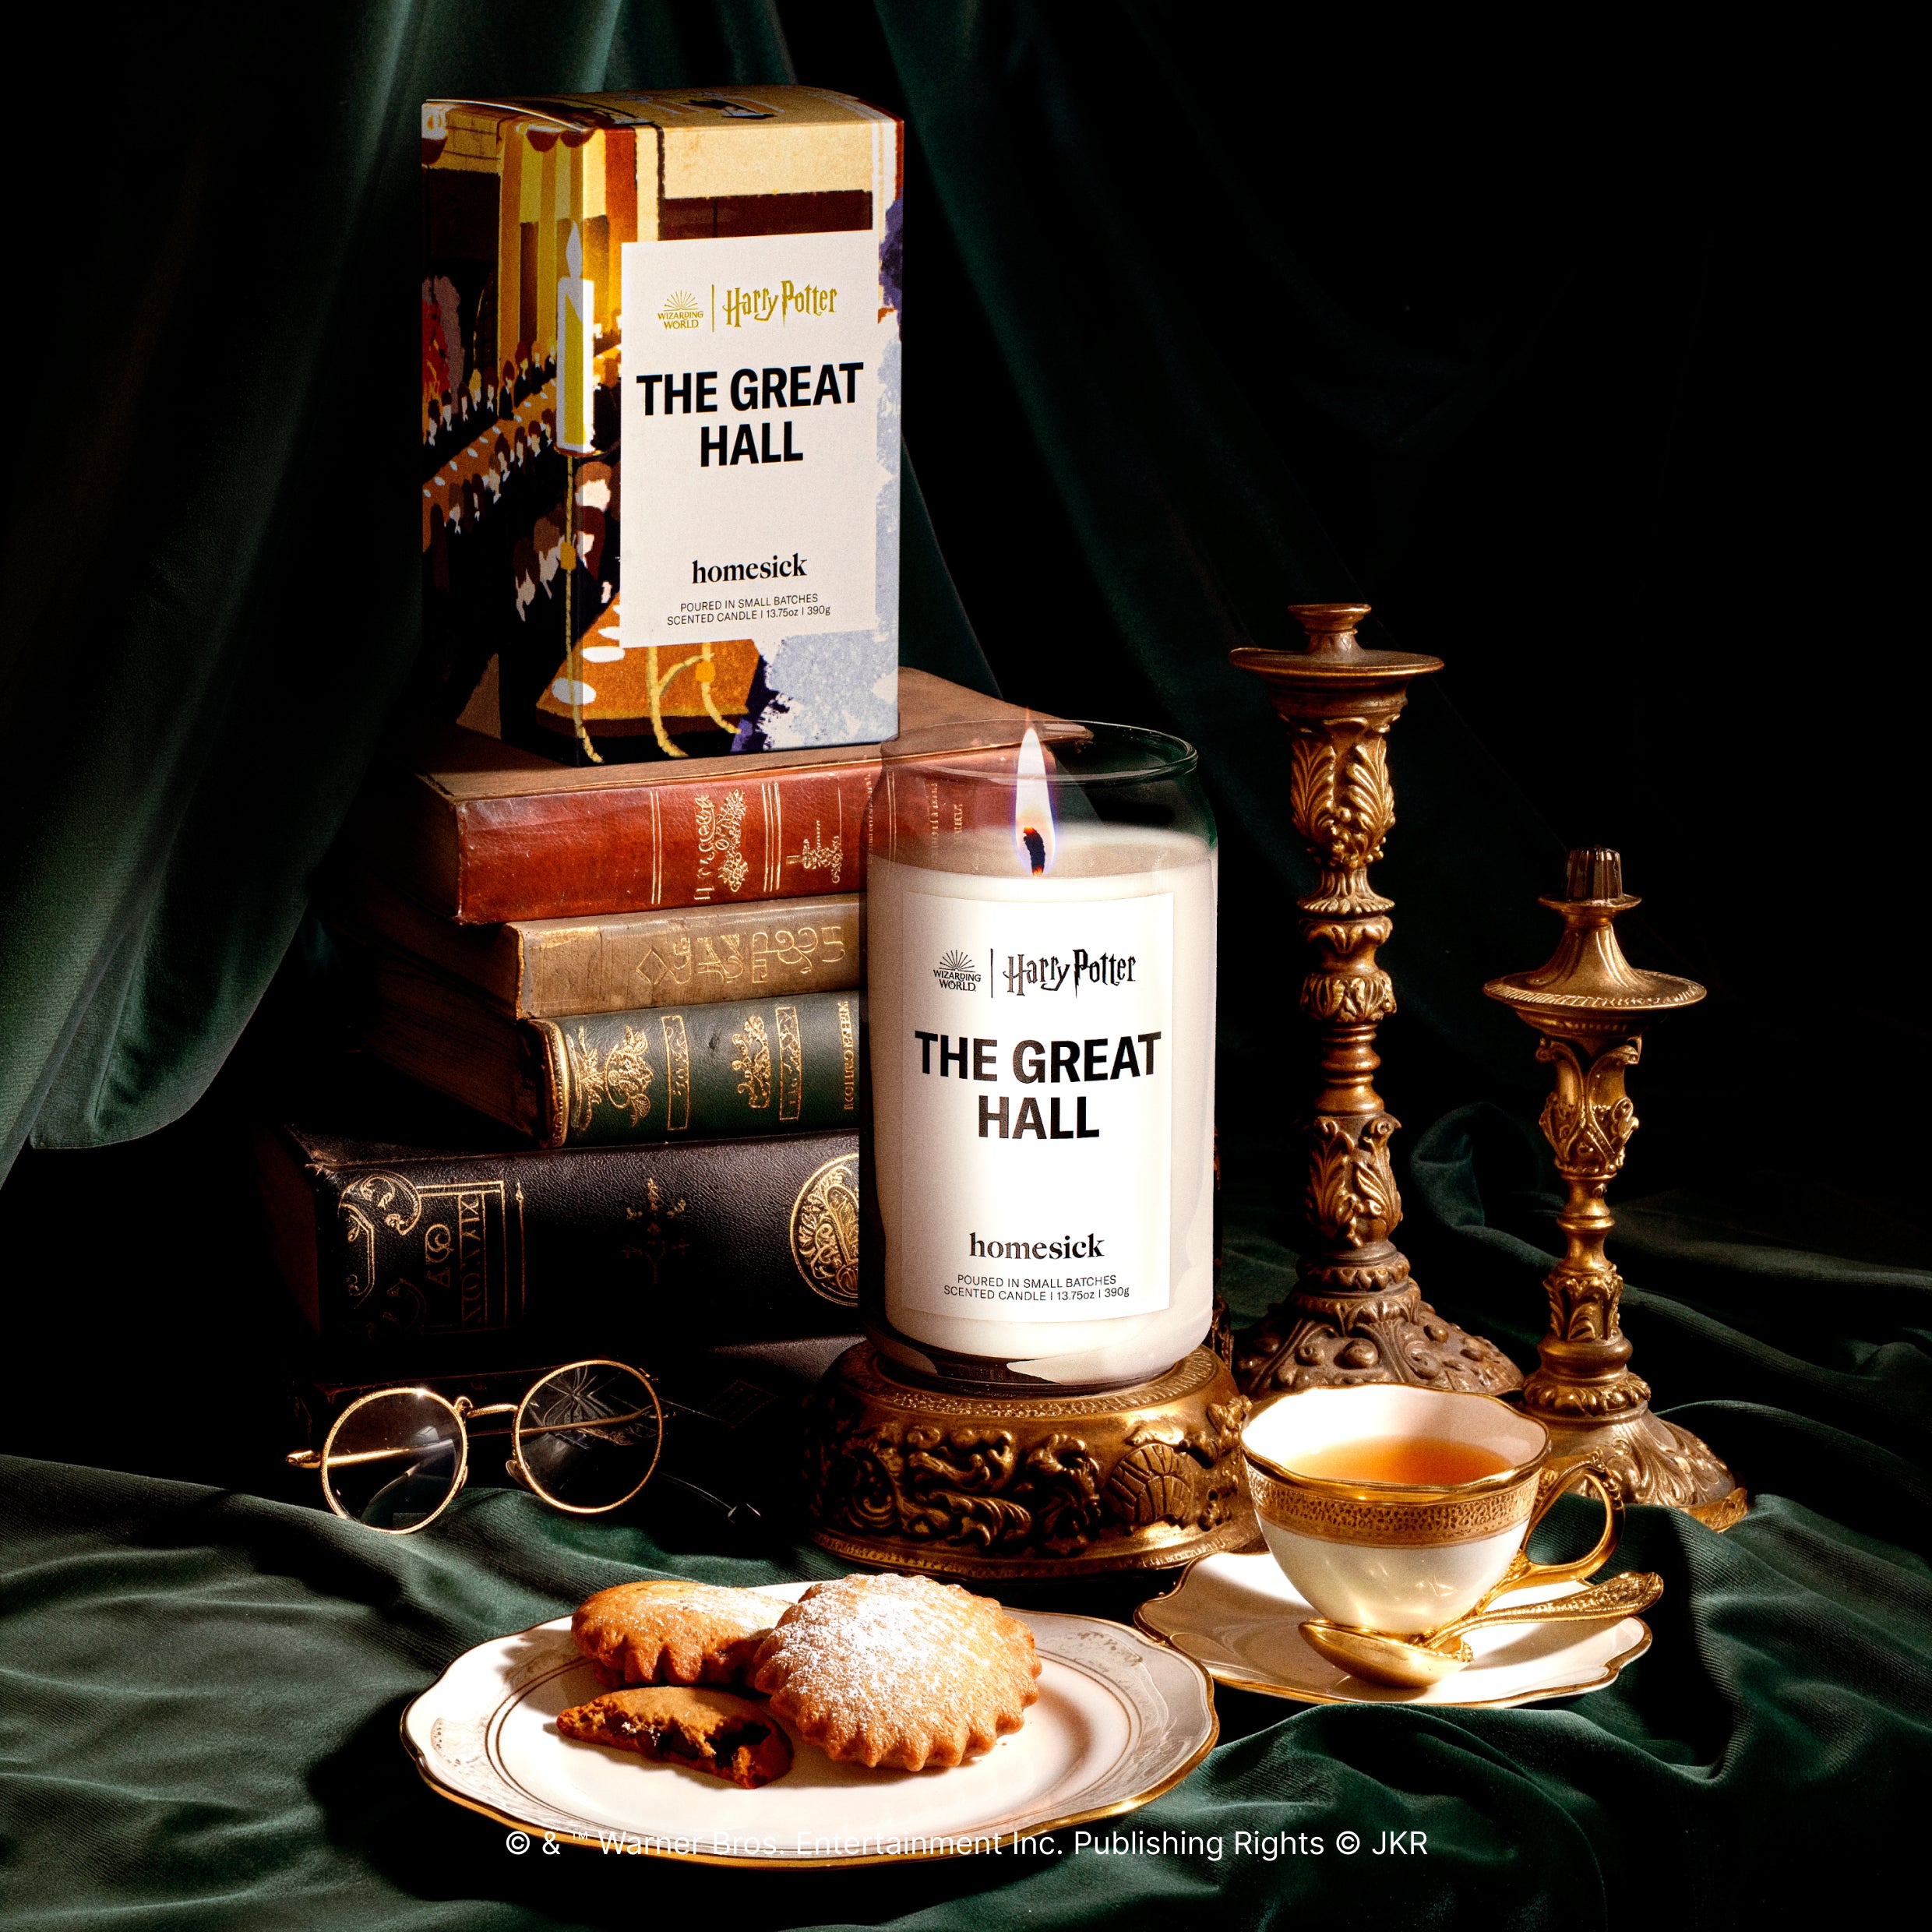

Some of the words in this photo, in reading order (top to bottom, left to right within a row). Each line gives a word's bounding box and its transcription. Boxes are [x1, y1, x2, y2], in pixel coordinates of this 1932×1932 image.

[658, 311, 704, 319] WIZARDING
[722, 287, 779, 328] Harry
[781, 280, 837, 328] Potter
[664, 319, 699, 330] WORLD
[636, 371, 717, 416] THE
[730, 361, 864, 411] GREAT
[701, 421, 803, 467] HALL
[692, 552, 808, 583] homesick
[680, 601, 722, 612] POURED
[724, 600, 735, 609] IN
[738, 597, 771, 608] SMALL
[774, 594, 818, 606] BATCHES
[667, 612, 714, 626] SCENTED
[717, 610, 757, 622] CANDLE
[766, 607, 799, 619] 13.75oz
[807, 605, 830, 615] 390g
[933, 969, 982, 982] WIZARDING
[939, 979, 976, 992] WORLD
[1003, 954, 1070, 996] Harry
[1073, 949, 1136, 999] Potter
[915, 1030, 997, 1081] THE
[1013, 1031, 1162, 1084] GREAT
[978, 1095, 1099, 1140] HALL
[969, 1232, 1105, 1260] homesick
[943, 1285, 995, 1299] SCENTED
[999, 1291, 1046, 1301] CANDLE
[1057, 1291, 1095, 1301] 13.75oz
[1104, 1286, 1130, 1298] 390g
[957, 1274, 1003, 1287] POURED
[1008, 1278, 1019, 1288] IN
[1024, 1278, 1063, 1289] SMALL
[1066, 1274, 1116, 1288] BATCHES
